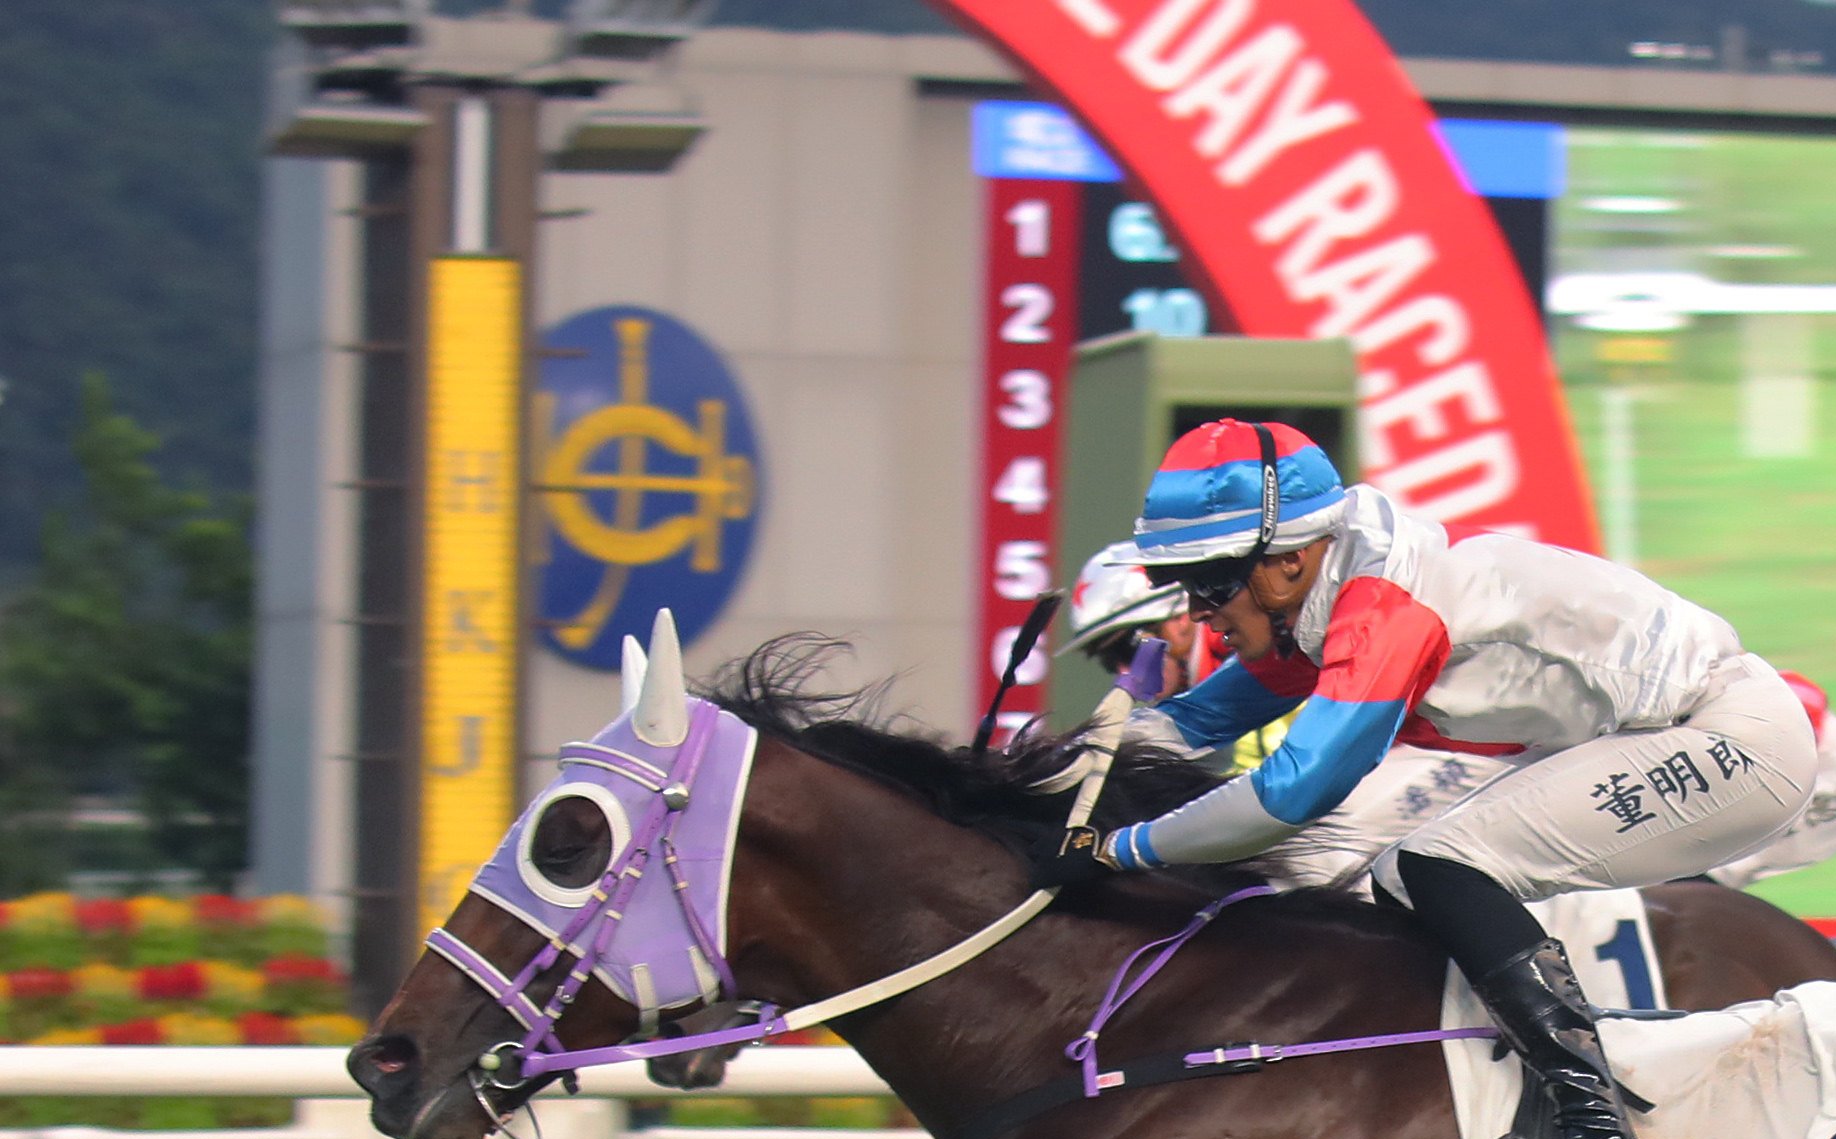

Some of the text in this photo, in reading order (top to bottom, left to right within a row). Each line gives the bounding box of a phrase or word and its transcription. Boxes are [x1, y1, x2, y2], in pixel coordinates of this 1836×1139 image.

[1003, 200, 1051, 258] 1
[1057, 0, 1540, 540] DAY RACED
[1000, 283, 1053, 343] 2
[997, 369, 1053, 430] 3
[993, 456, 1049, 514] 4
[993, 540, 1051, 600] 5
[1595, 918, 1657, 1011] 1
